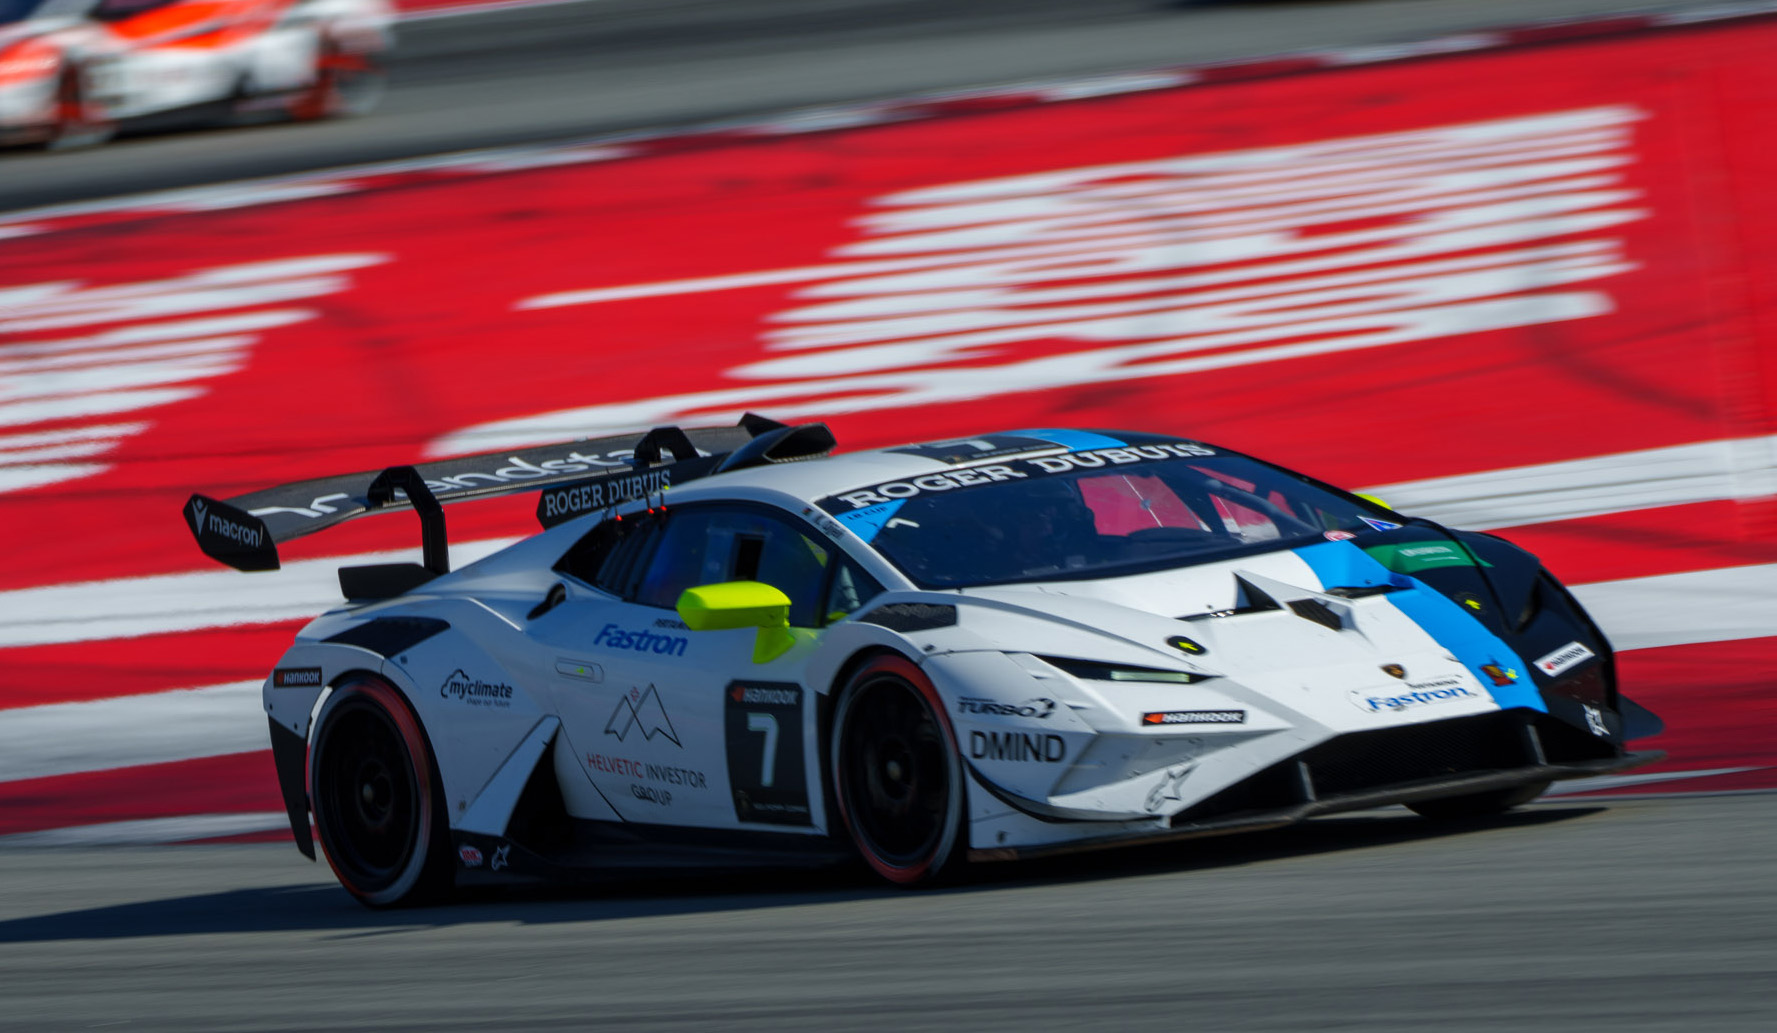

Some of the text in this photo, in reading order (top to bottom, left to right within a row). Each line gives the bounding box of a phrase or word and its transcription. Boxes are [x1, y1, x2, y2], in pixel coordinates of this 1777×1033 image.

[837, 442, 1217, 510] ROGER DUBUIS
[544, 469, 671, 518] ROGER DUBUIS
[209, 513, 259, 548] macron
[593, 623, 688, 656] Fastron
[449, 679, 513, 700] myclimate
[1364, 686, 1471, 710] Fastron
[746, 711, 780, 788] 7
[968, 729, 1066, 763] DMIND
[586, 752, 707, 790] HELVETIC INVESTOR
[630, 783, 673, 806] GROUP
